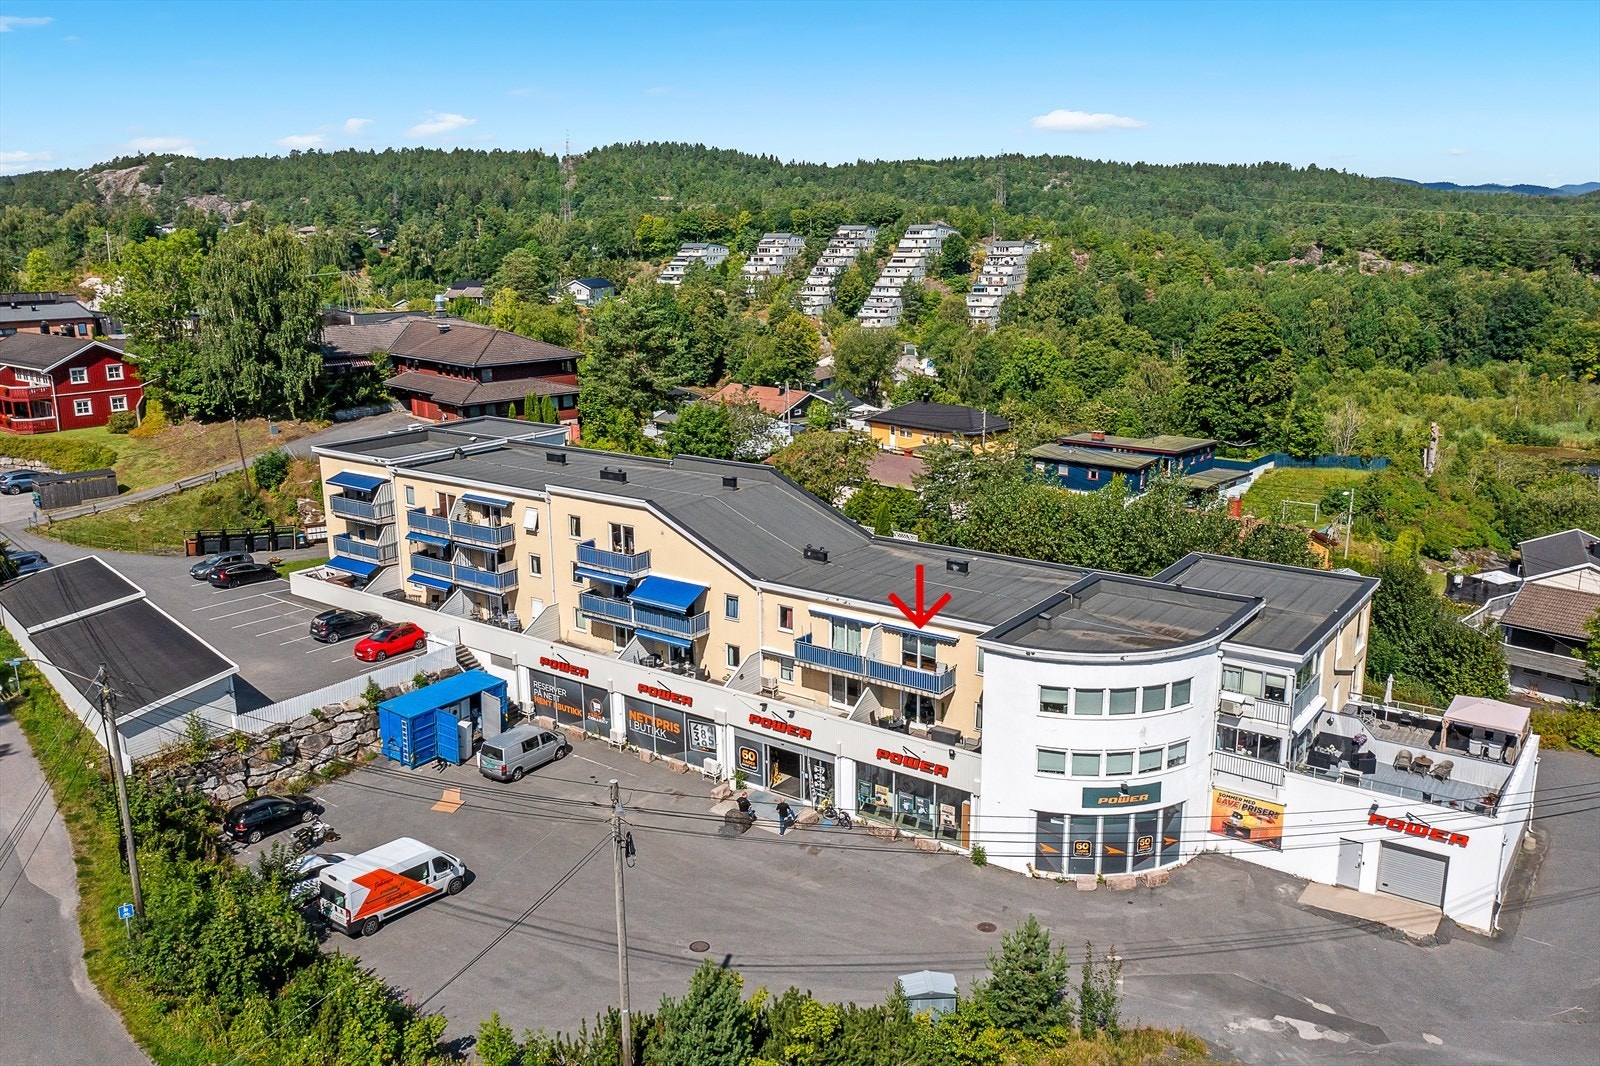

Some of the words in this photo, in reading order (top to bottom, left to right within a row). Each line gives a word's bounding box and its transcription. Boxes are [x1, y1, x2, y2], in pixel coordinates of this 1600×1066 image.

[540, 656, 589, 679] POWER
[533, 680, 567, 697] RESERVER
[533, 688, 543, 698] PÅ
[638, 683, 693, 707] POWER
[534, 696, 552, 707] HENT
[557, 703, 582, 717] BUTIKK
[628, 709, 680, 734] NETTPRIS
[634, 720, 667, 739] BUTIKK
[749, 713, 812, 740] POWER
[742, 749, 756, 762] 60
[876, 748, 949, 778] POWER
[1097, 793, 1149, 805] POWER
[1216, 797, 1240, 809] LAVE
[1218, 792, 1243, 802] SOMMER
[1368, 813, 1470, 848] POWER
